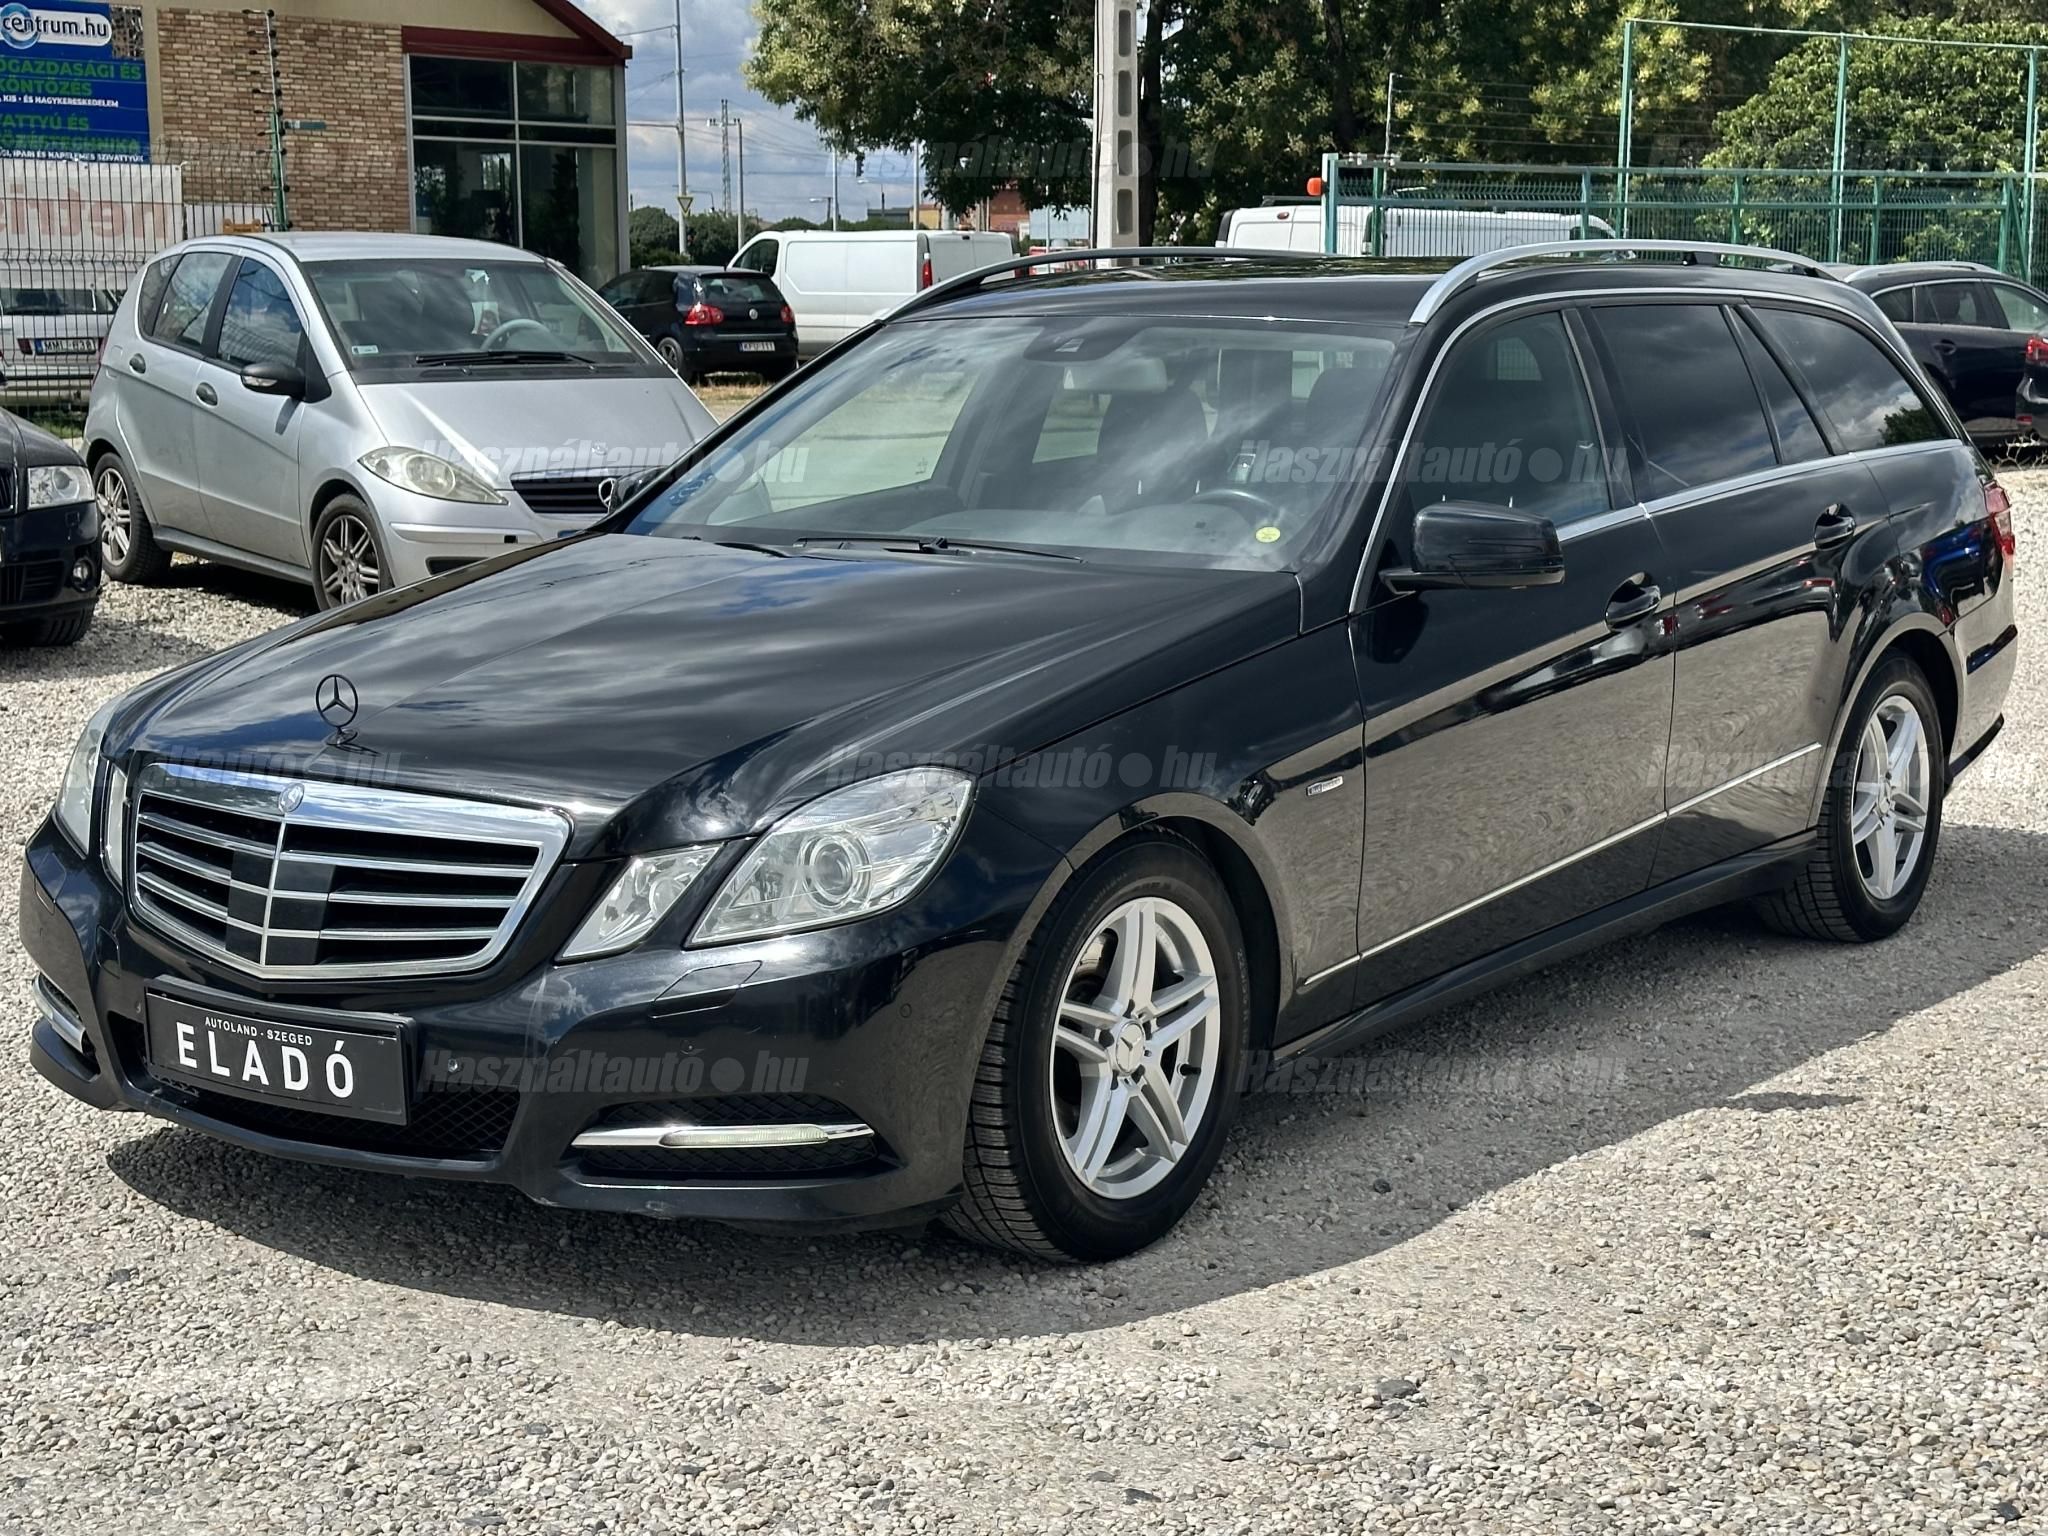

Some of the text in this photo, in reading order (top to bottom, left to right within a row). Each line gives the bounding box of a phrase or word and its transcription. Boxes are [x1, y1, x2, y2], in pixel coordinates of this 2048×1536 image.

[120, 62, 142, 80] ÉS
[0, 112, 89, 131] ATTYÚ ÉS
[205, 1016, 257, 1037] AUTOLAND
[267, 1029, 313, 1047] SZEGED
[176, 1021, 354, 1099] ELADÓ
